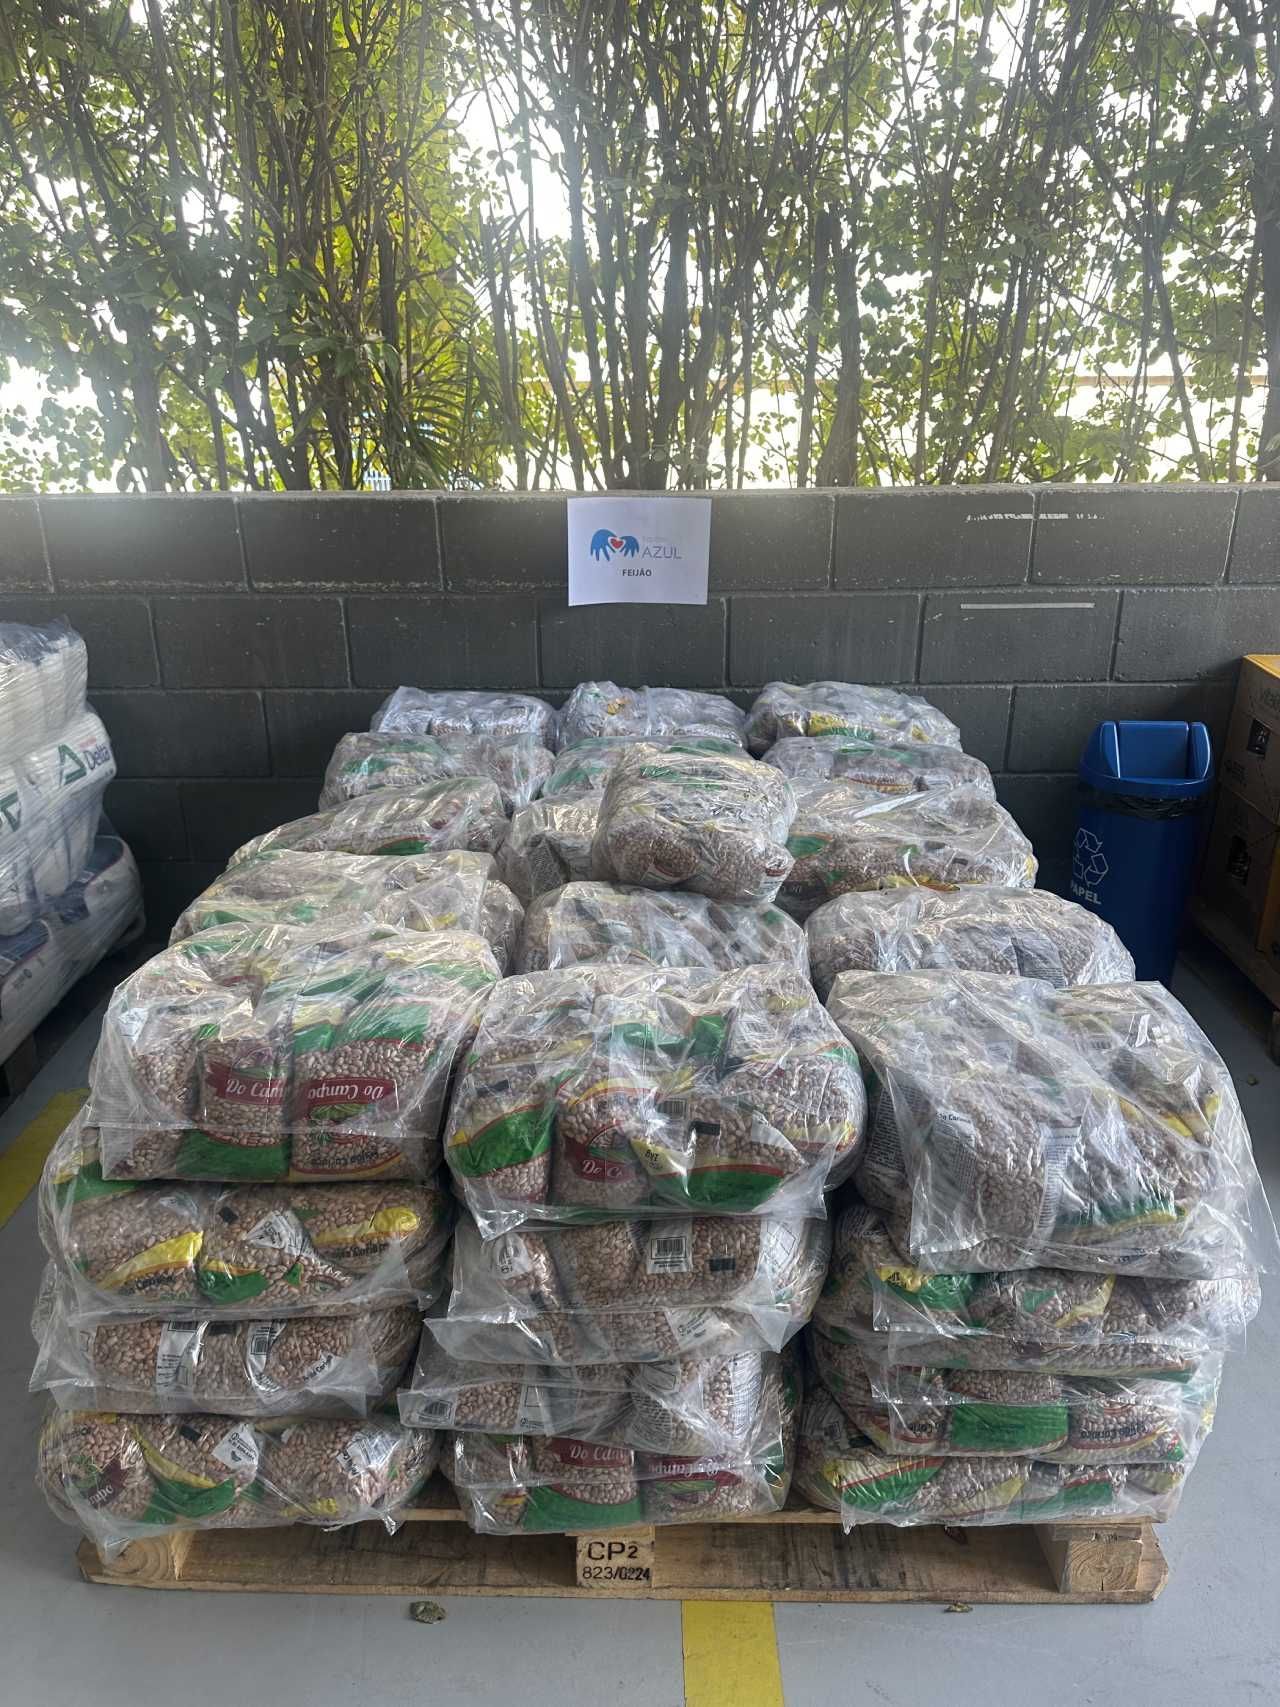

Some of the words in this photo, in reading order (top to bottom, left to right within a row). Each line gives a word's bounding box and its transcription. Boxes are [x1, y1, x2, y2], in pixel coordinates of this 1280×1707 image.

[641, 545, 683, 560] AZUL
[622, 566, 652, 577] FEIJÃO
[308, 1082, 358, 1099] Campo
[364, 1085, 385, 1099] Do
[569, 1445, 589, 1460] Do
[87, 1483, 114, 1505] mpo
[582, 1566, 651, 1581] 823/0224
